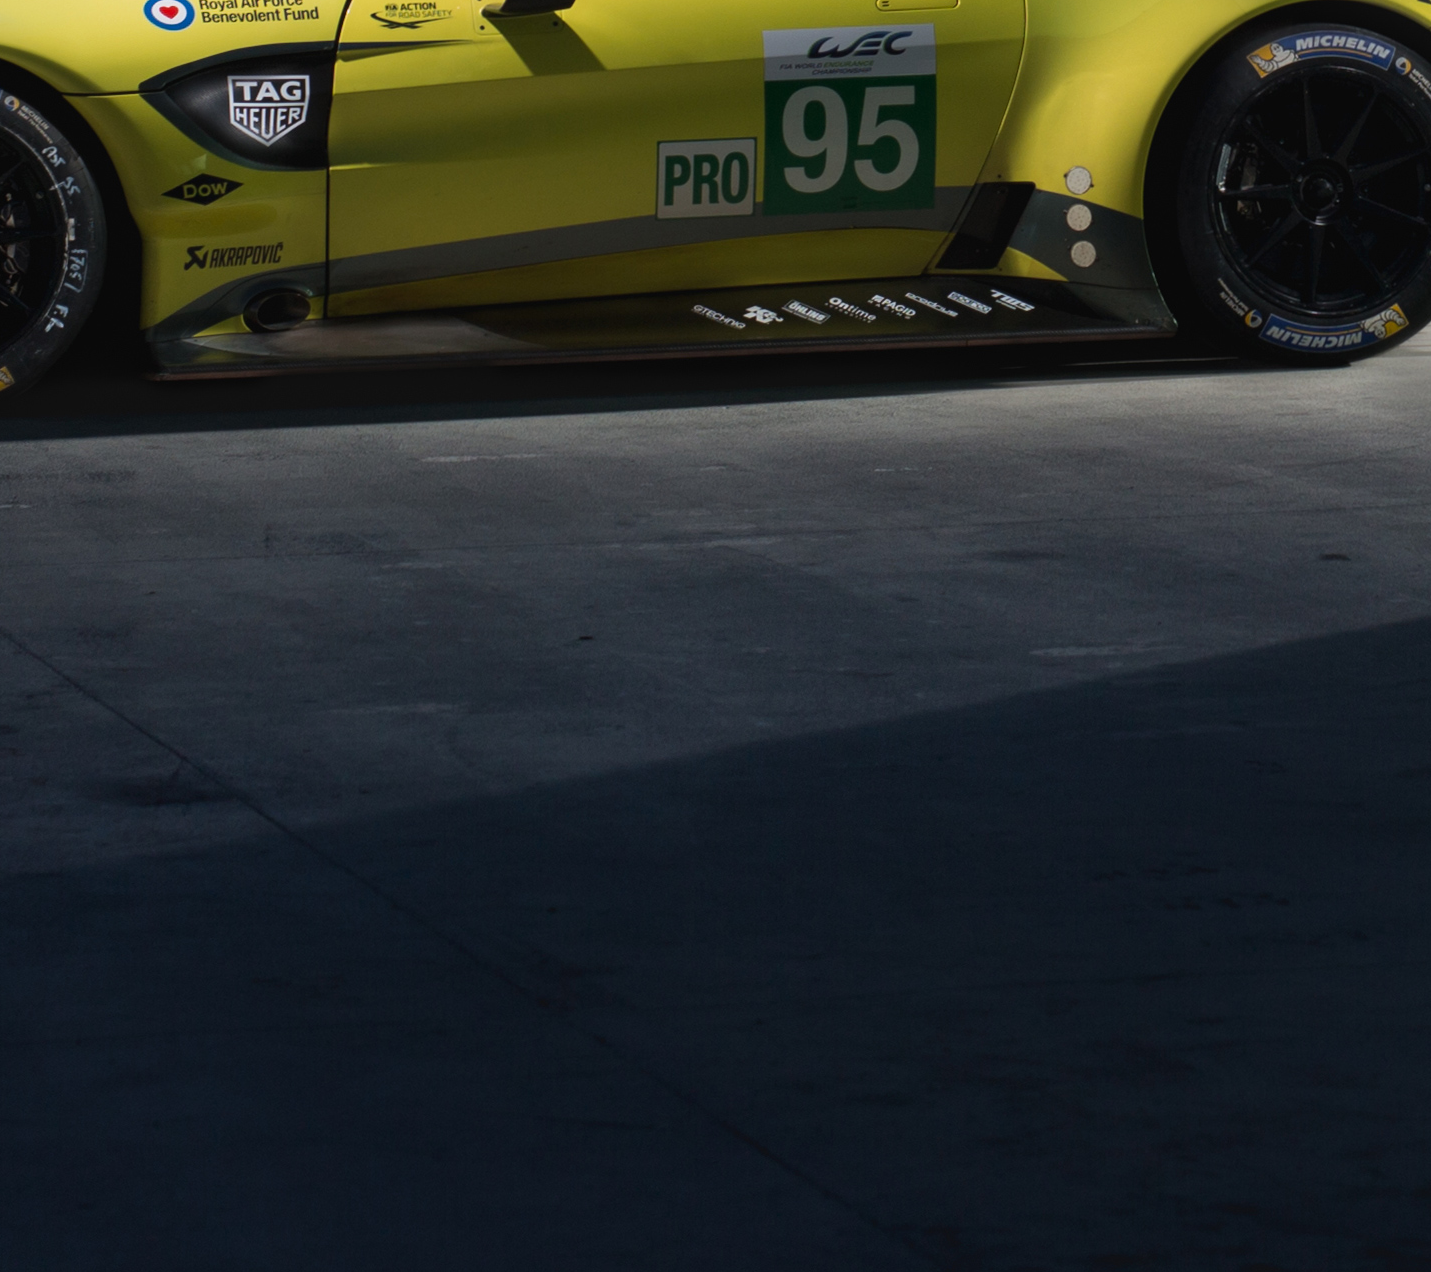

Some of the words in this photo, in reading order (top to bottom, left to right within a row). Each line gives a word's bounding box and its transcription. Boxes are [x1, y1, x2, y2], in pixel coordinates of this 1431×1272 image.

[201, 8, 282, 24] Benevolent
[283, 6, 320, 22] Fund
[398, 10, 421, 19] ROAD
[421, 9, 454, 18] SAFETY
[400, 2, 437, 12] ACTION
[1295, 35, 1392, 60] MICHELIN
[811, 67, 873, 76] CHAMPIONSHIP
[823, 59, 875, 69] ENDURANCE
[235, 80, 303, 102] TAG
[20, 105, 50, 130] MICHELIN
[235, 107, 301, 140] HEUER
[782, 85, 919, 193] 95
[663, 151, 750, 207] PRO
[829, 296, 877, 321] Ontime
[881, 298, 917, 317] PAGID
[1266, 325, 1364, 348] MICHELIN
